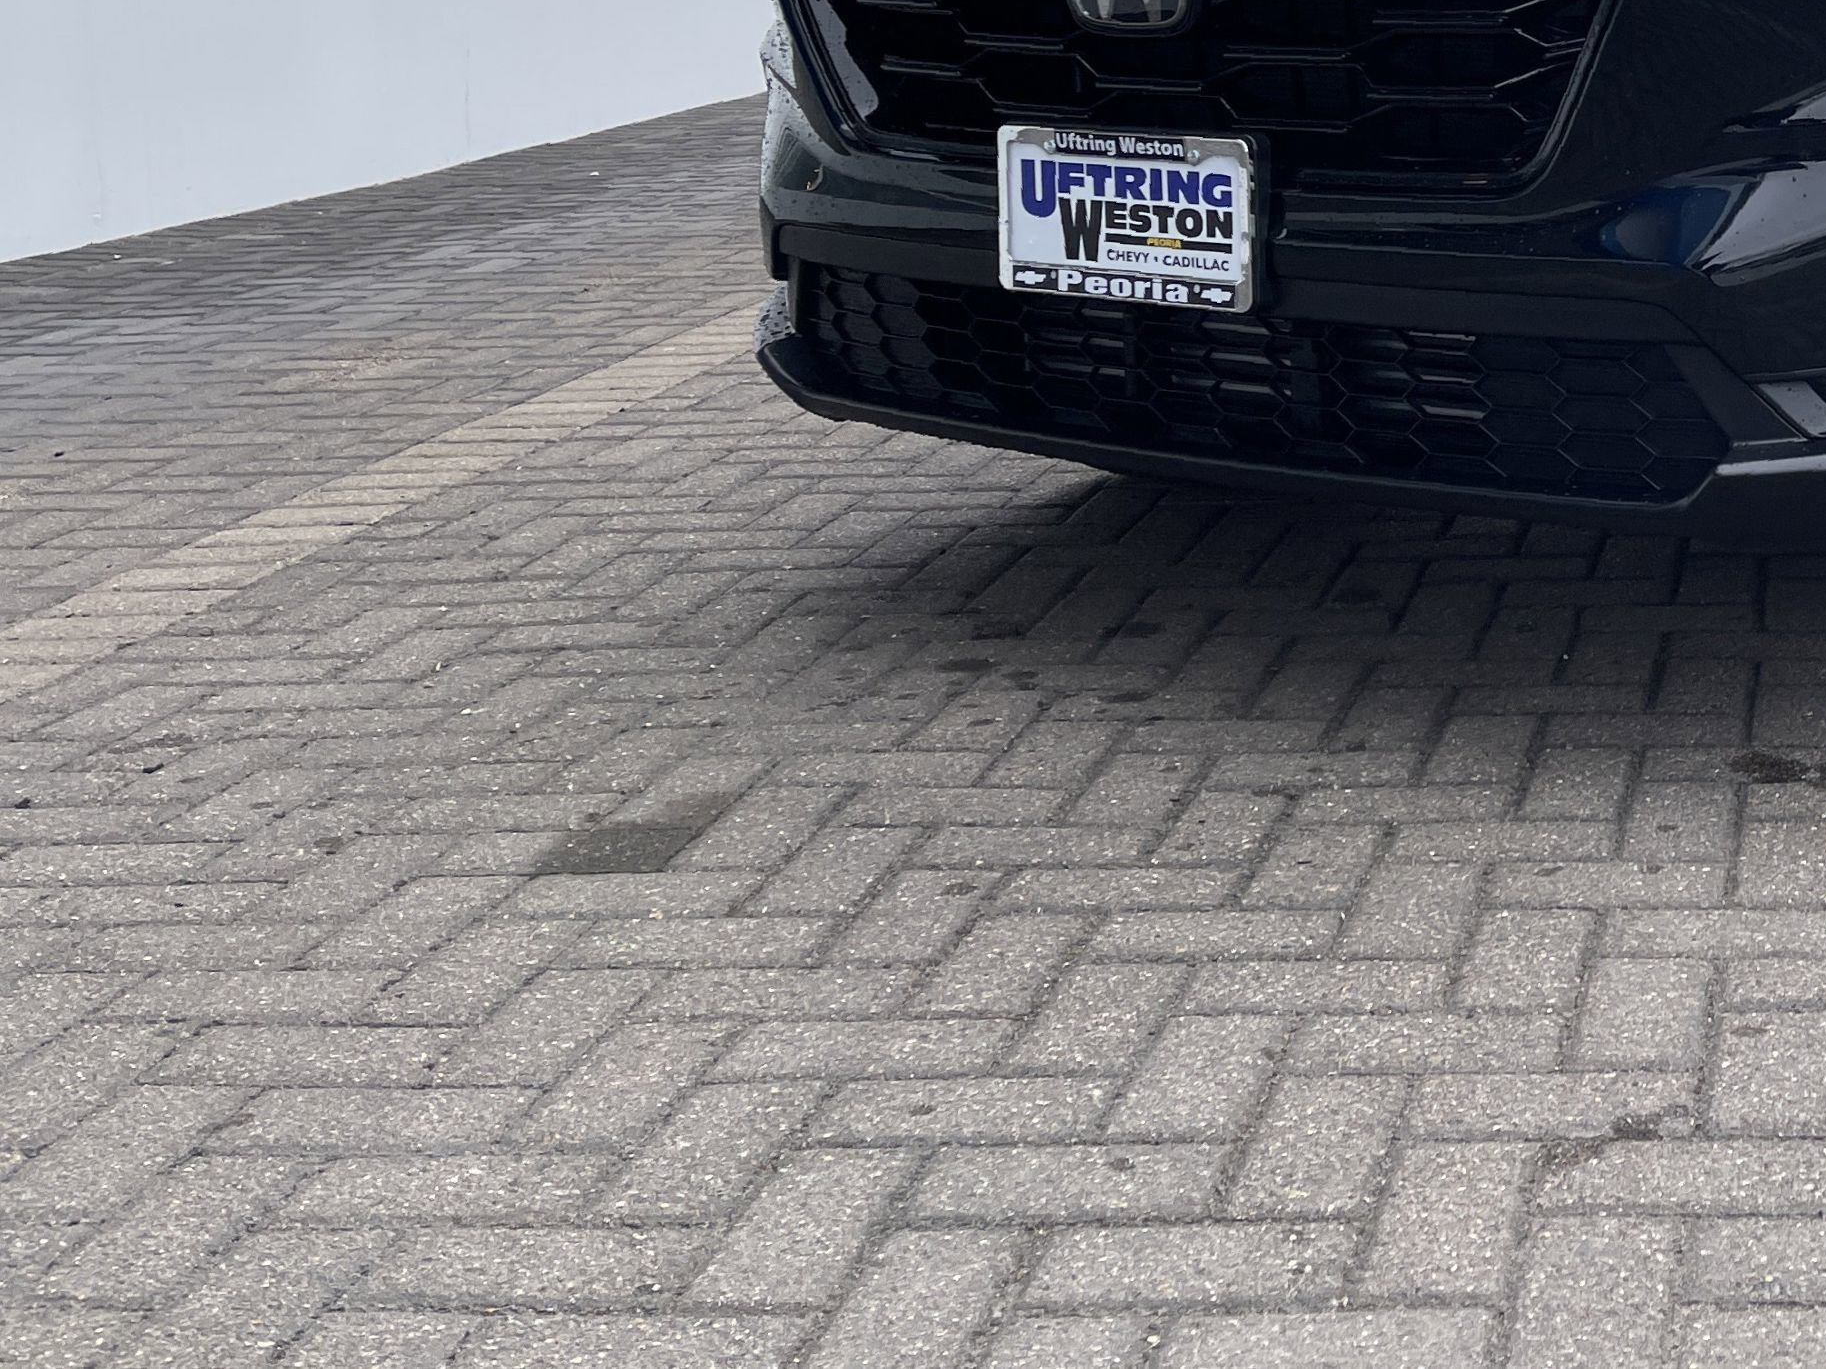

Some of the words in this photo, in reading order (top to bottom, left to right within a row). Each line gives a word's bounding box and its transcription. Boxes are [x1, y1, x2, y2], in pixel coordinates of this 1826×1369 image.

[1055, 131, 1117, 156] Uftring
[1118, 136, 1184, 157] Weston
[1020, 158, 1233, 219] UFTRING
[1059, 196, 1233, 263] WESTON
[1146, 237, 1182, 249] PEORIA
[1106, 248, 1150, 264] CHEVY
[1162, 255, 1230, 272] CADILLAC
[1057, 269, 1189, 304] Peoria
